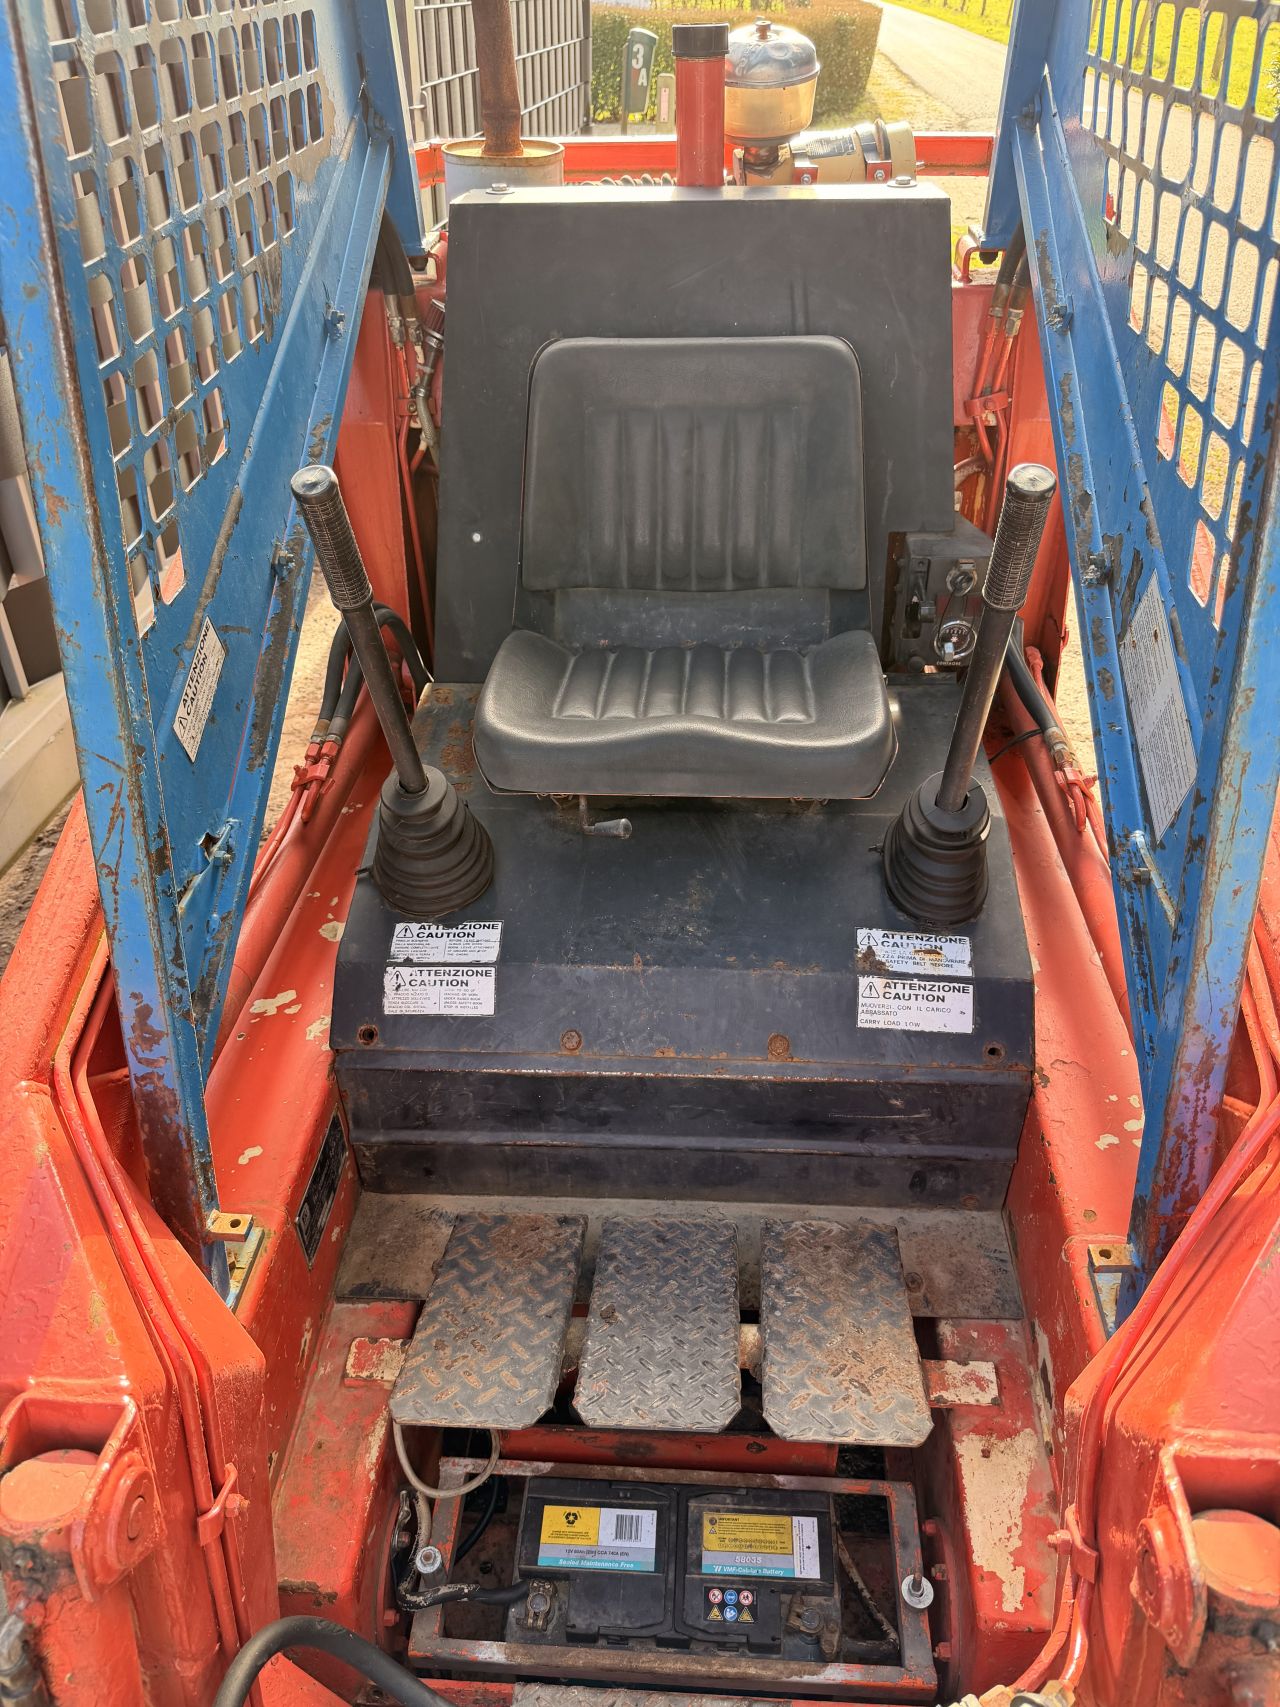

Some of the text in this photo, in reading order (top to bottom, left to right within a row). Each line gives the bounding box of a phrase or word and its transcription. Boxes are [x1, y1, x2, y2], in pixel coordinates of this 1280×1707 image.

[632, 43, 645, 69] 3
[638, 68, 648, 87] A
[181, 621, 211, 709] ATTENZIONE
[186, 654, 208, 717] CAUTION
[882, 932, 967, 945] ATTENZIONE
[881, 940, 943, 951] CAUTION
[408, 979, 469, 987] CAUTION
[883, 981, 971, 994] ATTENZIONE
[882, 991, 946, 1003] CAUTION
[925, 1006, 952, 1014] CARICO
[859, 1018, 881, 1026] CARRY
[558, 1558, 580, 1566] Sealed
[620, 1561, 634, 1569] Free
[762, 1568, 785, 1577] Battery
